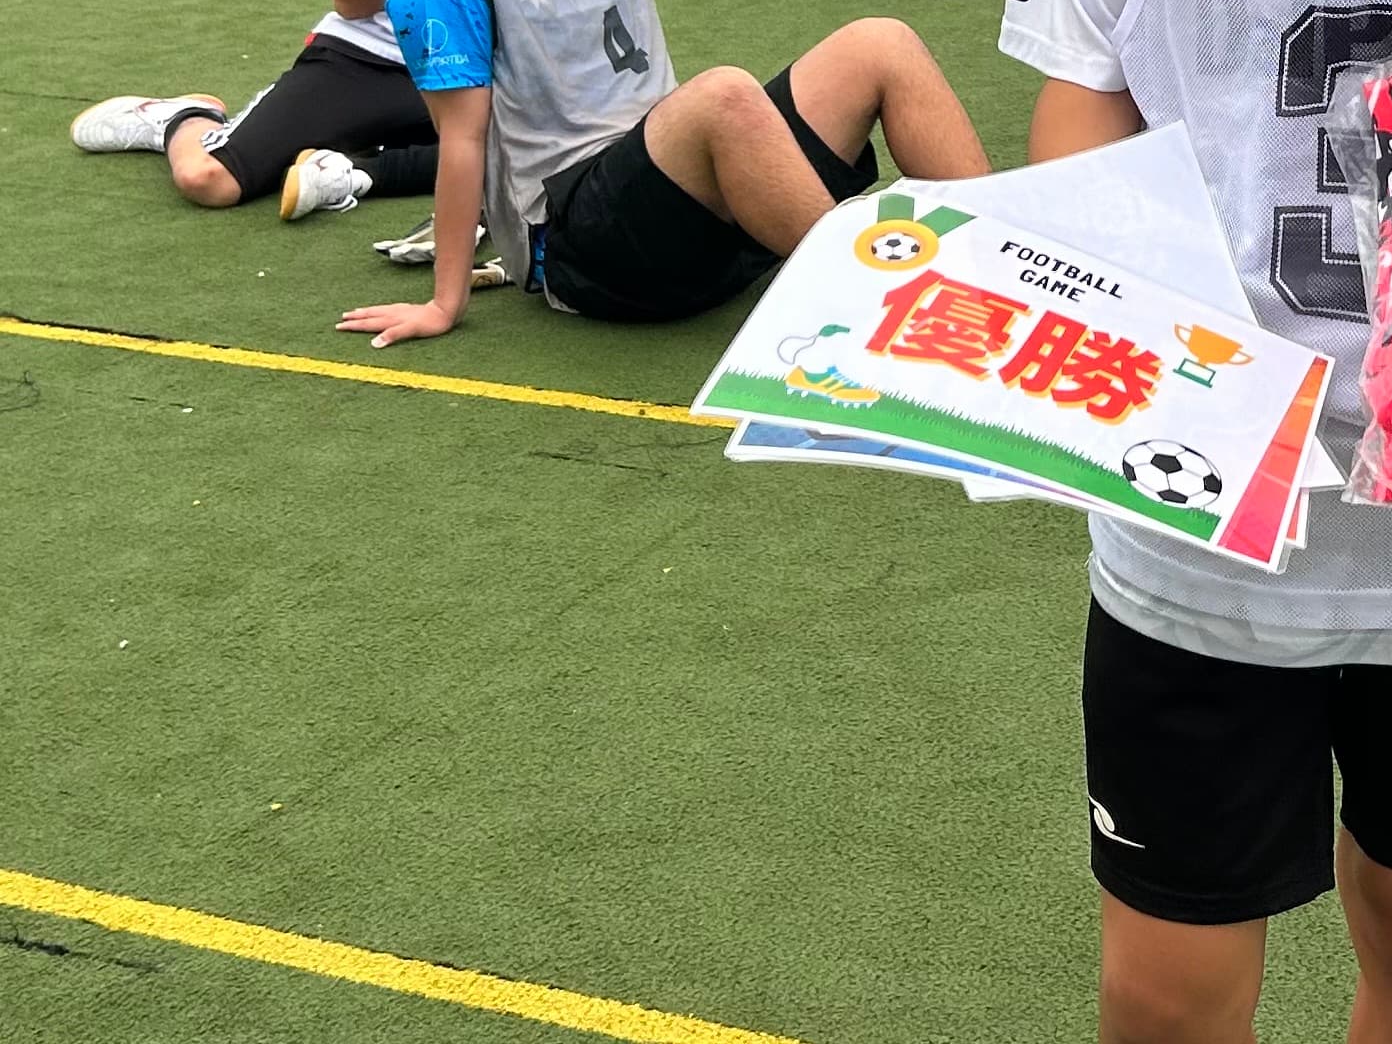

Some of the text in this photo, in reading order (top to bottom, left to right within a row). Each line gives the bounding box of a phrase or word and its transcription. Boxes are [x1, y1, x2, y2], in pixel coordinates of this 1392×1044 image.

[604, 5, 649, 74] 4
[1000, 241, 1122, 299] FOOTBALL
[1019, 269, 1086, 302] GAME
[864, 269, 1164, 424] 優勝
